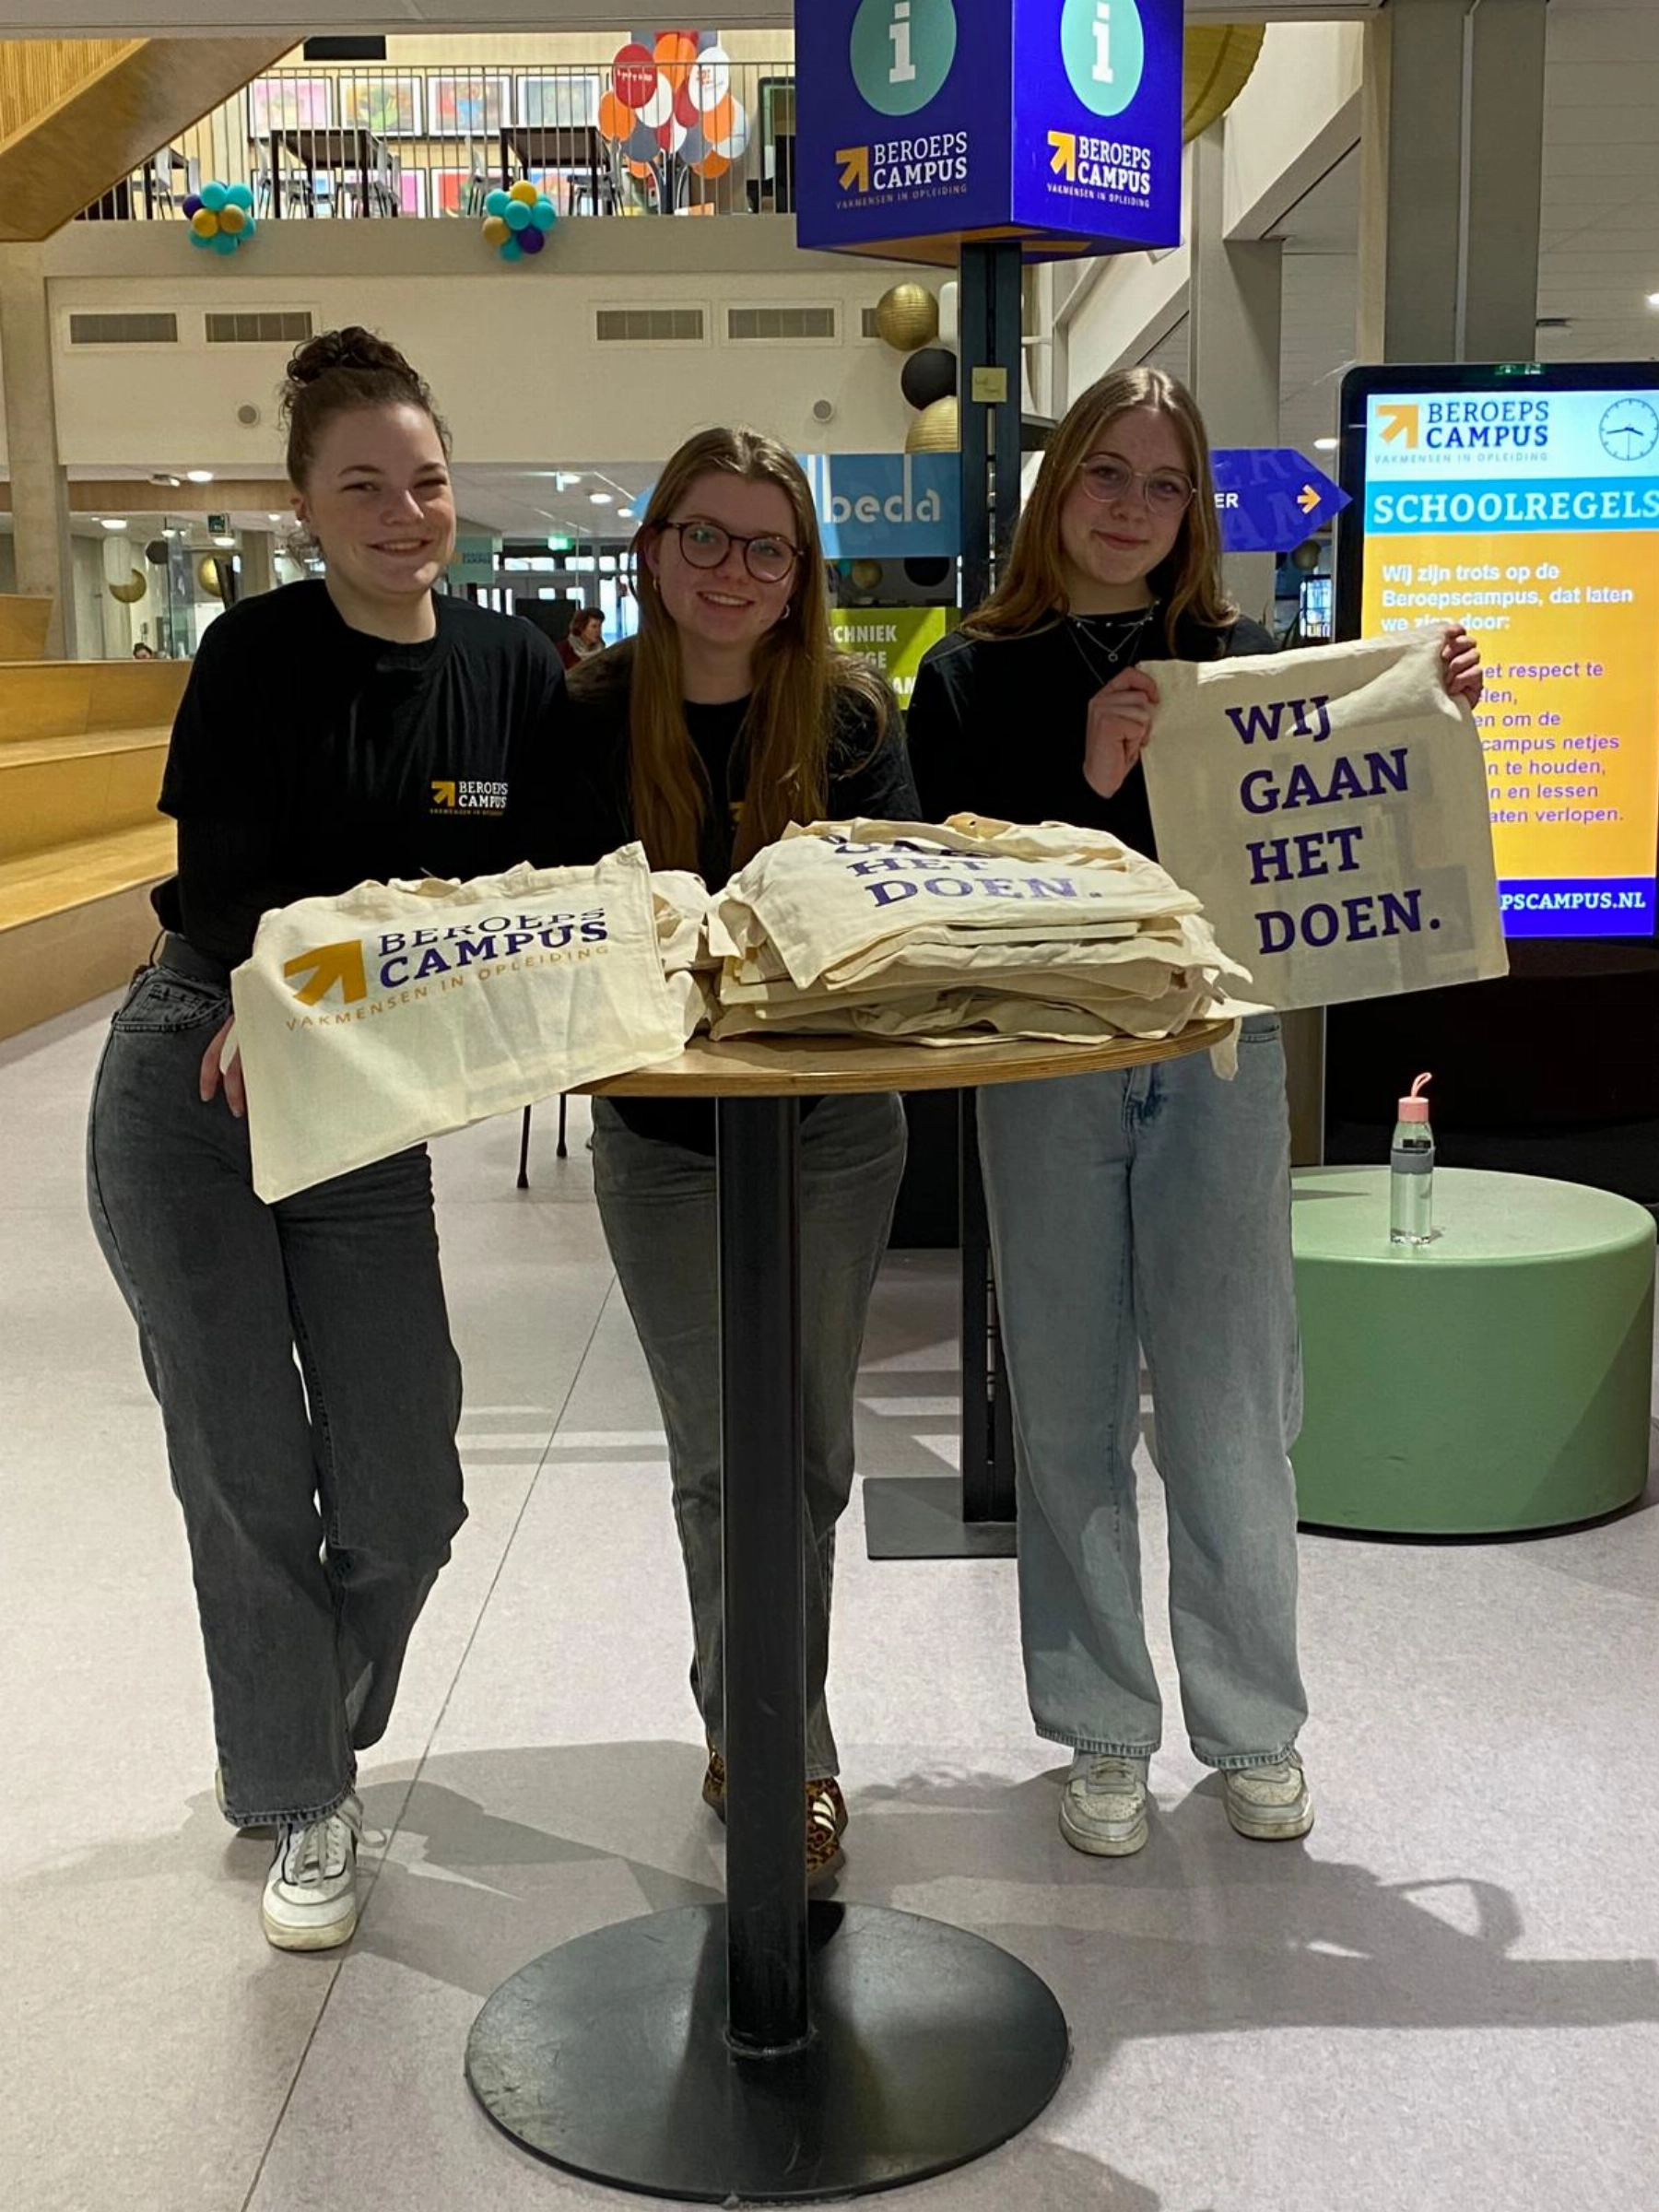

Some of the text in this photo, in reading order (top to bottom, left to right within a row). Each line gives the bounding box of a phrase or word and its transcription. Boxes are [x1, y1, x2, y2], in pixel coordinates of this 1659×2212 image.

[874, 131, 967, 166] BEROEPS
[1078, 135, 1150, 171] BEROEPS
[873, 156, 967, 191] CAMPUS
[1077, 160, 1150, 194] CAMPUS
[897, 192, 908, 202] IN
[912, 183, 967, 199] OPLEIDING
[1097, 192, 1106, 201] IN
[1428, 400, 1549, 424] BEROEPS
[1426, 425, 1549, 449] CAMPUS
[1374, 452, 1548, 465] VAKMENSEN IN OPLEIDING
[1373, 489, 1658, 524] SCHOOLREGELS
[1382, 561, 1559, 586] Wij zijn trots op de
[1382, 586, 1633, 610] Beroepscampus, dat laten
[1382, 618, 1408, 631] we
[1459, 613, 1511, 630] door:
[1482, 662, 1604, 681] et respect te
[1480, 688, 1518, 705] len,
[1226, 695, 1332, 745] WIJ
[1502, 715, 1531, 726] om
[1538, 712, 1560, 725] de
[1563, 734, 1620, 753] netjes
[1506, 761, 1523, 775] te
[1530, 759, 1606, 776] houden,
[1240, 747, 1408, 814] GAAN
[1508, 787, 1530, 799] en
[1537, 783, 1599, 799] lessen
[1536, 807, 1625, 825] verlopen.
[846, 857, 989, 877] HET
[1245, 826, 1364, 885] HET
[865, 877, 1103, 907] DOEN.
[378, 908, 606, 957] BEROEPS
[1254, 889, 1441, 955] DOEN.
[380, 921, 608, 988] CAMPUS
[286, 945, 611, 1031] VAKMENSEN IN OPLEIDING
